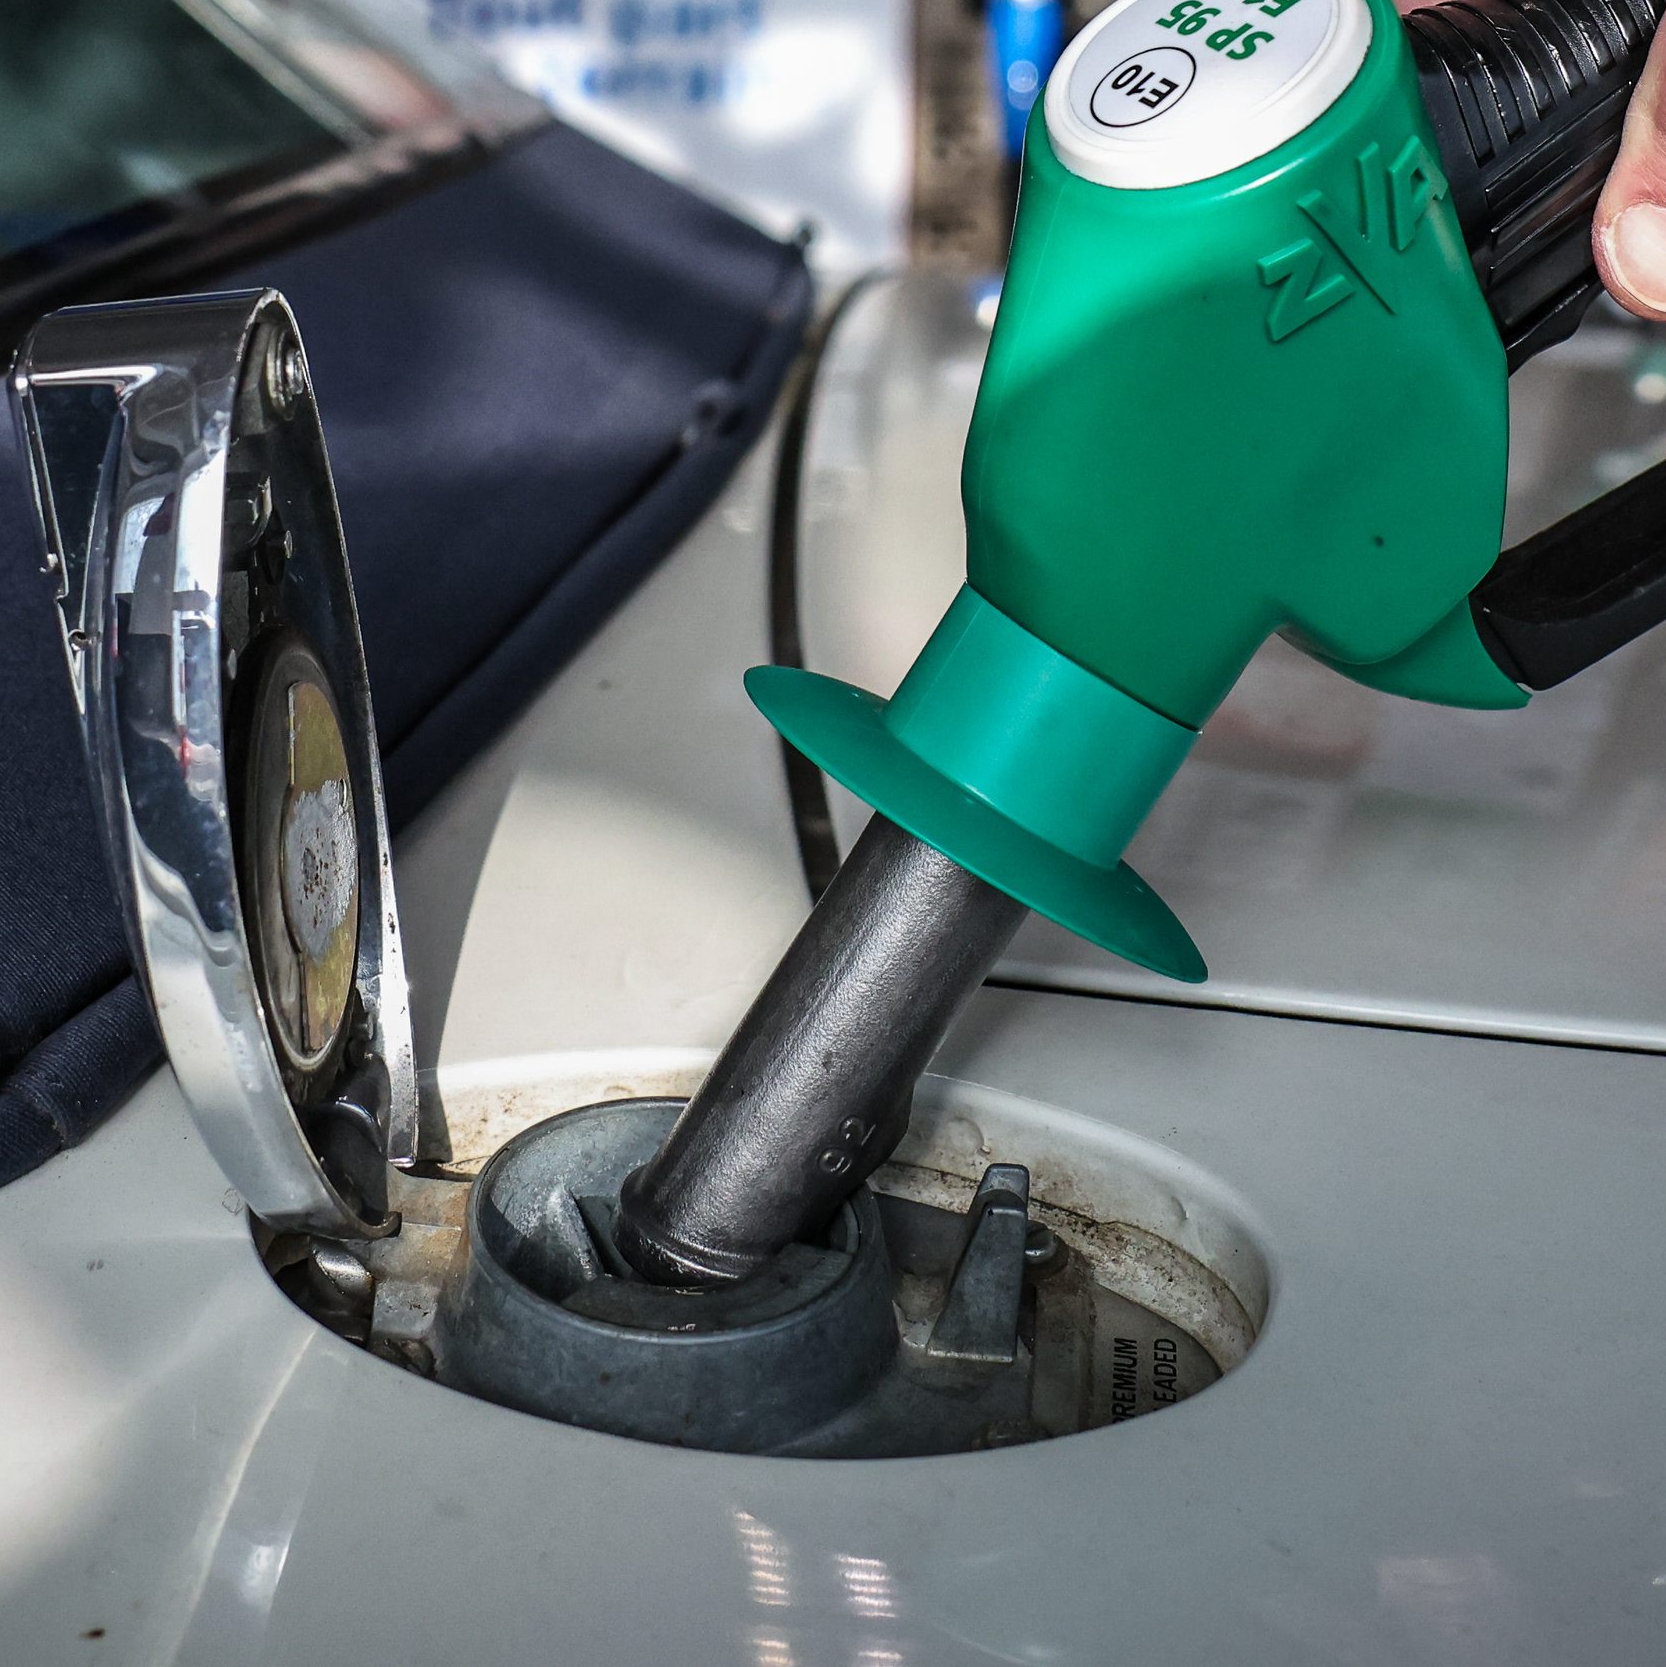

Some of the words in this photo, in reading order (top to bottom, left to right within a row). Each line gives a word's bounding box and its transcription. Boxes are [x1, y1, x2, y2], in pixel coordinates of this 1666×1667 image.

[1155, 0, 1222, 36] 95
[1205, 22, 1275, 61] SP
[1111, 64, 1180, 109] E10
[1153, 1337, 1178, 1409] EADED
